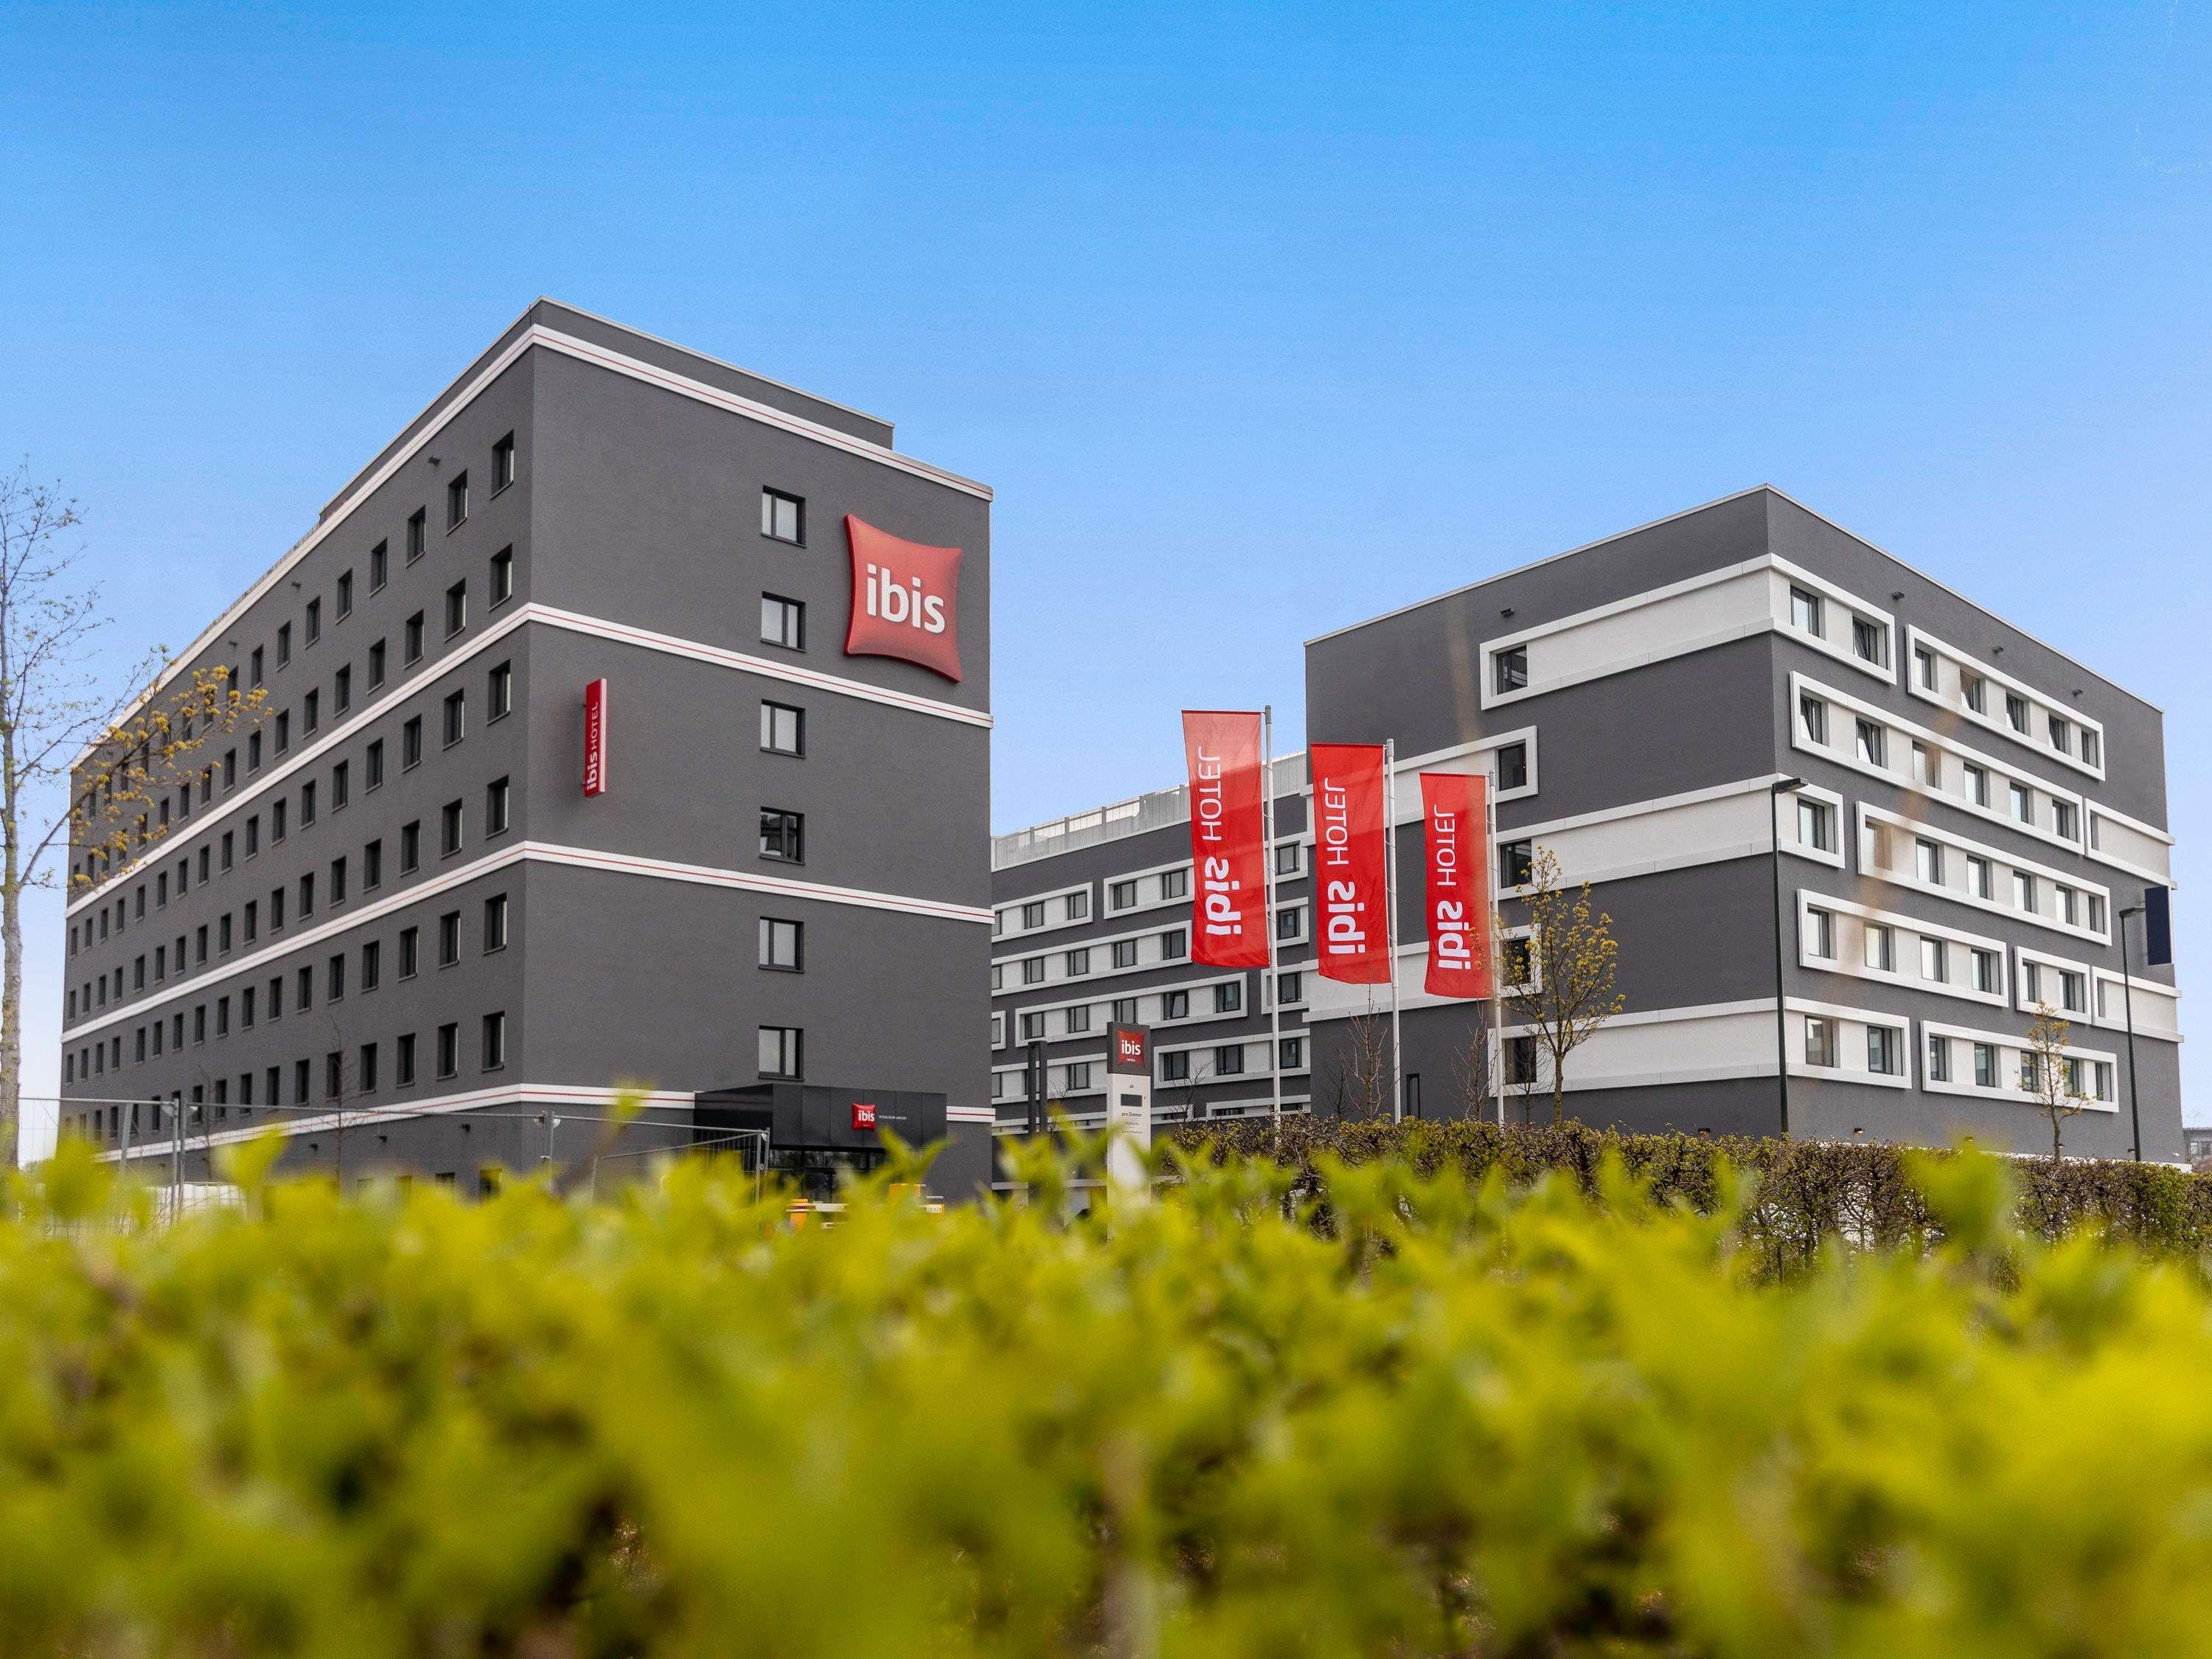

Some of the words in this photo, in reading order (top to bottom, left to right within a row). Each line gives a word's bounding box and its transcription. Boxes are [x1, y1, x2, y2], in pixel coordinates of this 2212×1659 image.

[867, 563, 945, 633] ibis
[587, 751, 598, 790] ibis
[1121, 1039, 1141, 1056] ibis
[858, 1110, 875, 1122] ibis
